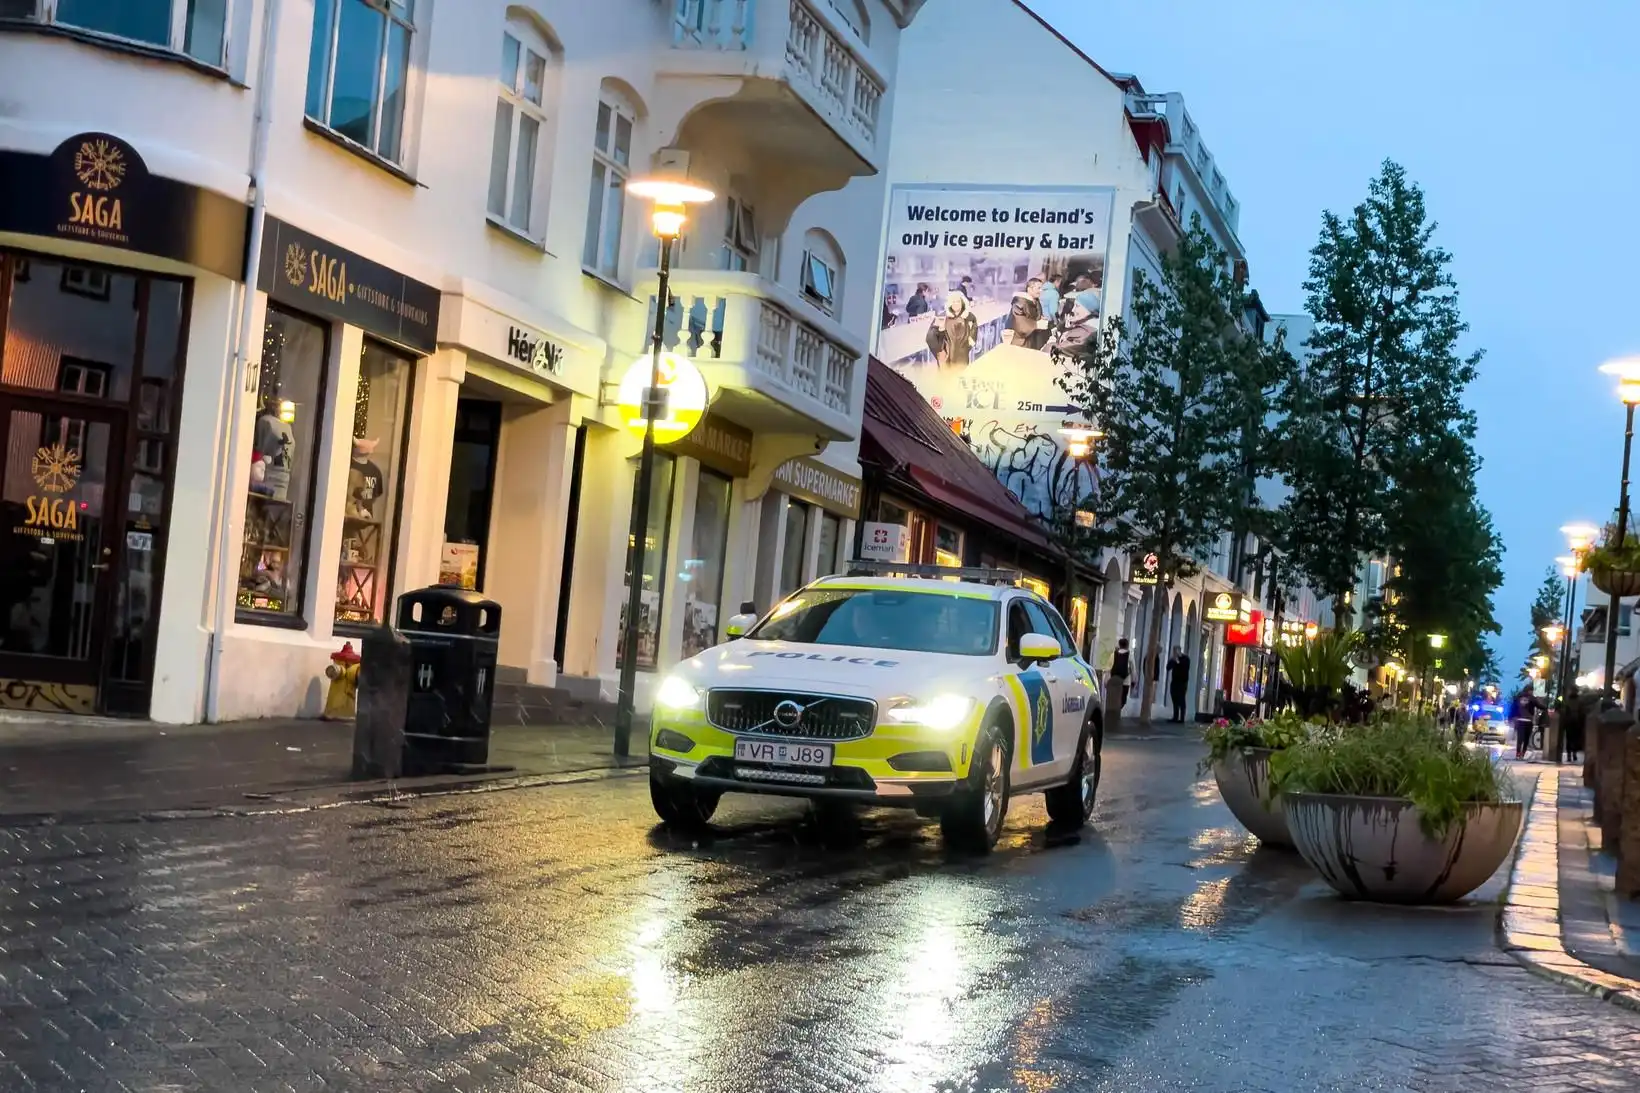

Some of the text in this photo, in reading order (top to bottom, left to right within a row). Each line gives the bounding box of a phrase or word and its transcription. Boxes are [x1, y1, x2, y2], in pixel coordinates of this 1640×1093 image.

[69, 192, 122, 229] SAGA
[907, 205, 1094, 224] Welcome to Iceland's
[902, 231, 1094, 250] only ice gallery & bar!
[309, 249, 346, 305] SAGA
[508, 326, 535, 363] Hér
[1017, 400, 1042, 412] 25m
[794, 462, 859, 509] SUPERMARKET
[25, 496, 76, 530] SAGA
[746, 651, 899, 668] POLICE
[750, 744, 824, 764] VR J89
